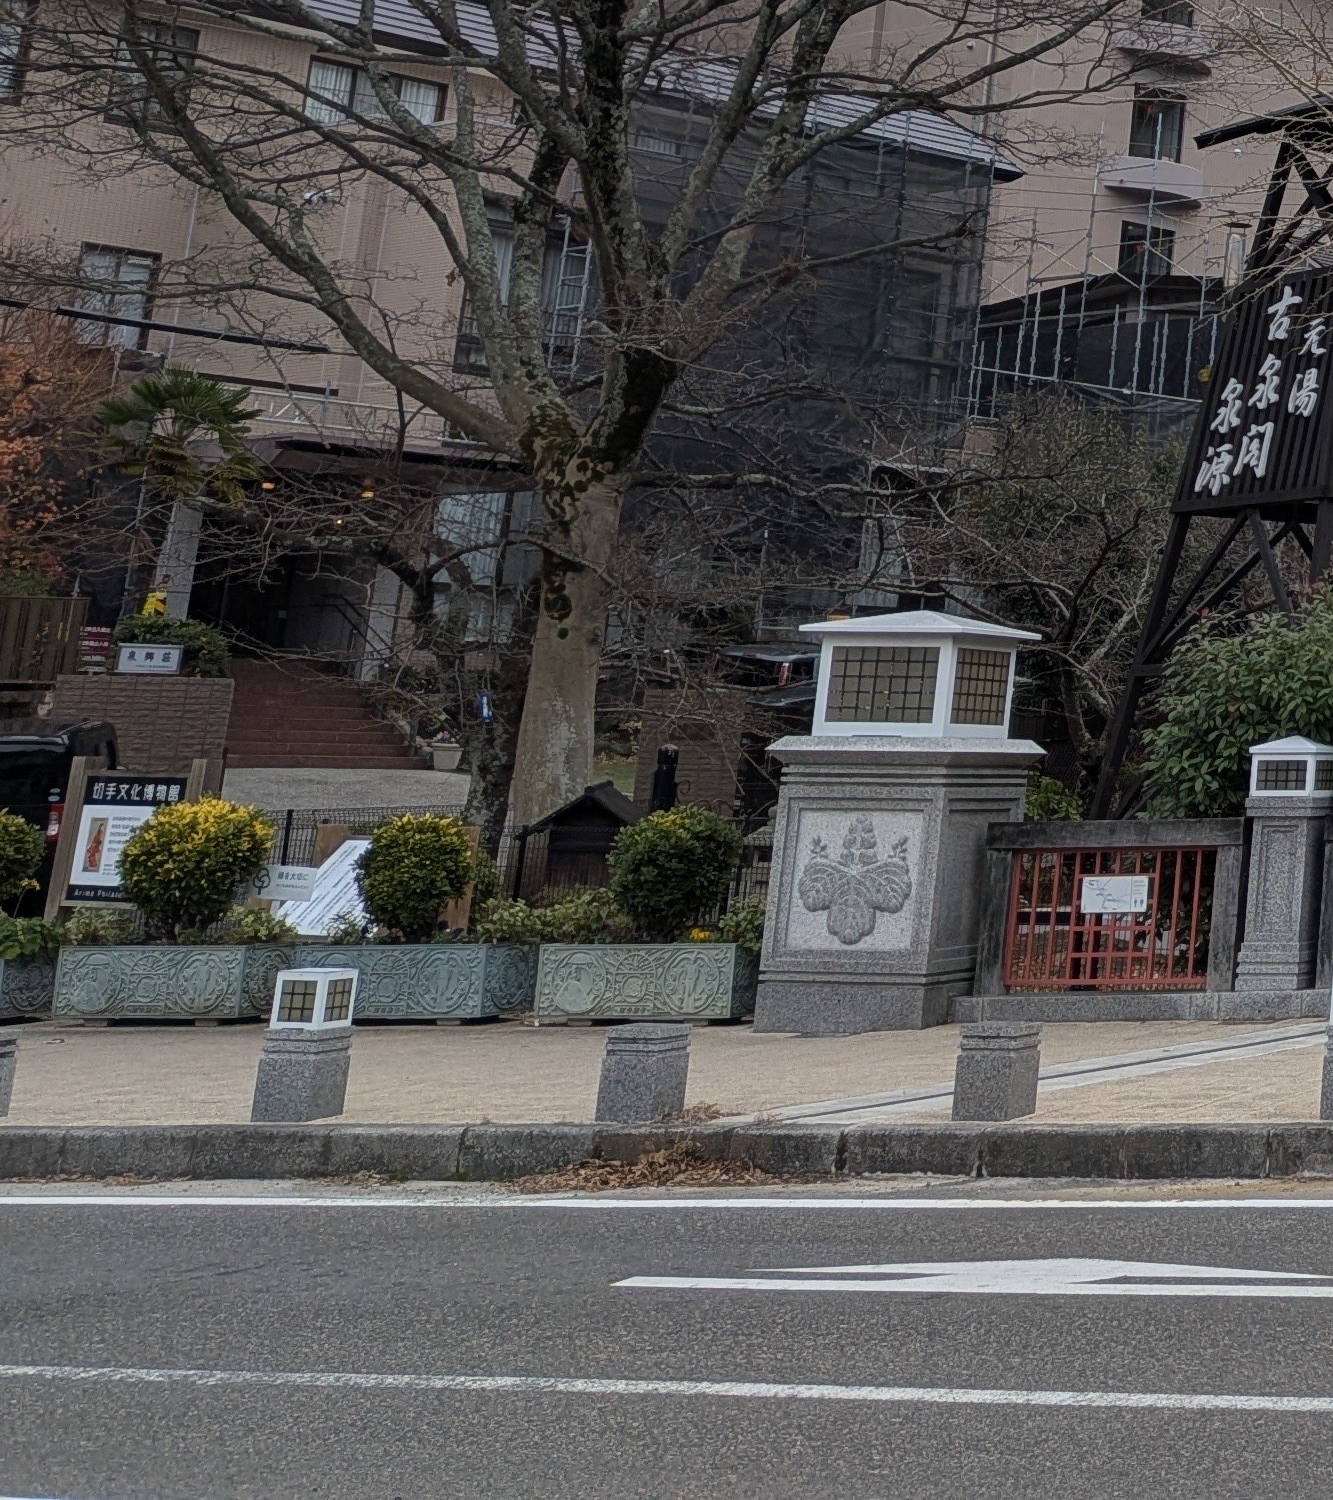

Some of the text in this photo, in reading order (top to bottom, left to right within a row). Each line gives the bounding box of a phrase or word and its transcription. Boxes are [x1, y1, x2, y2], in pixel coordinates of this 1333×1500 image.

[1232, 285, 1303, 479] 古泉閣
[1287, 316, 1327, 418] 元湯
[1194, 376, 1244, 497] 泉源
[92, 782, 181, 801] 切手文化博物館
